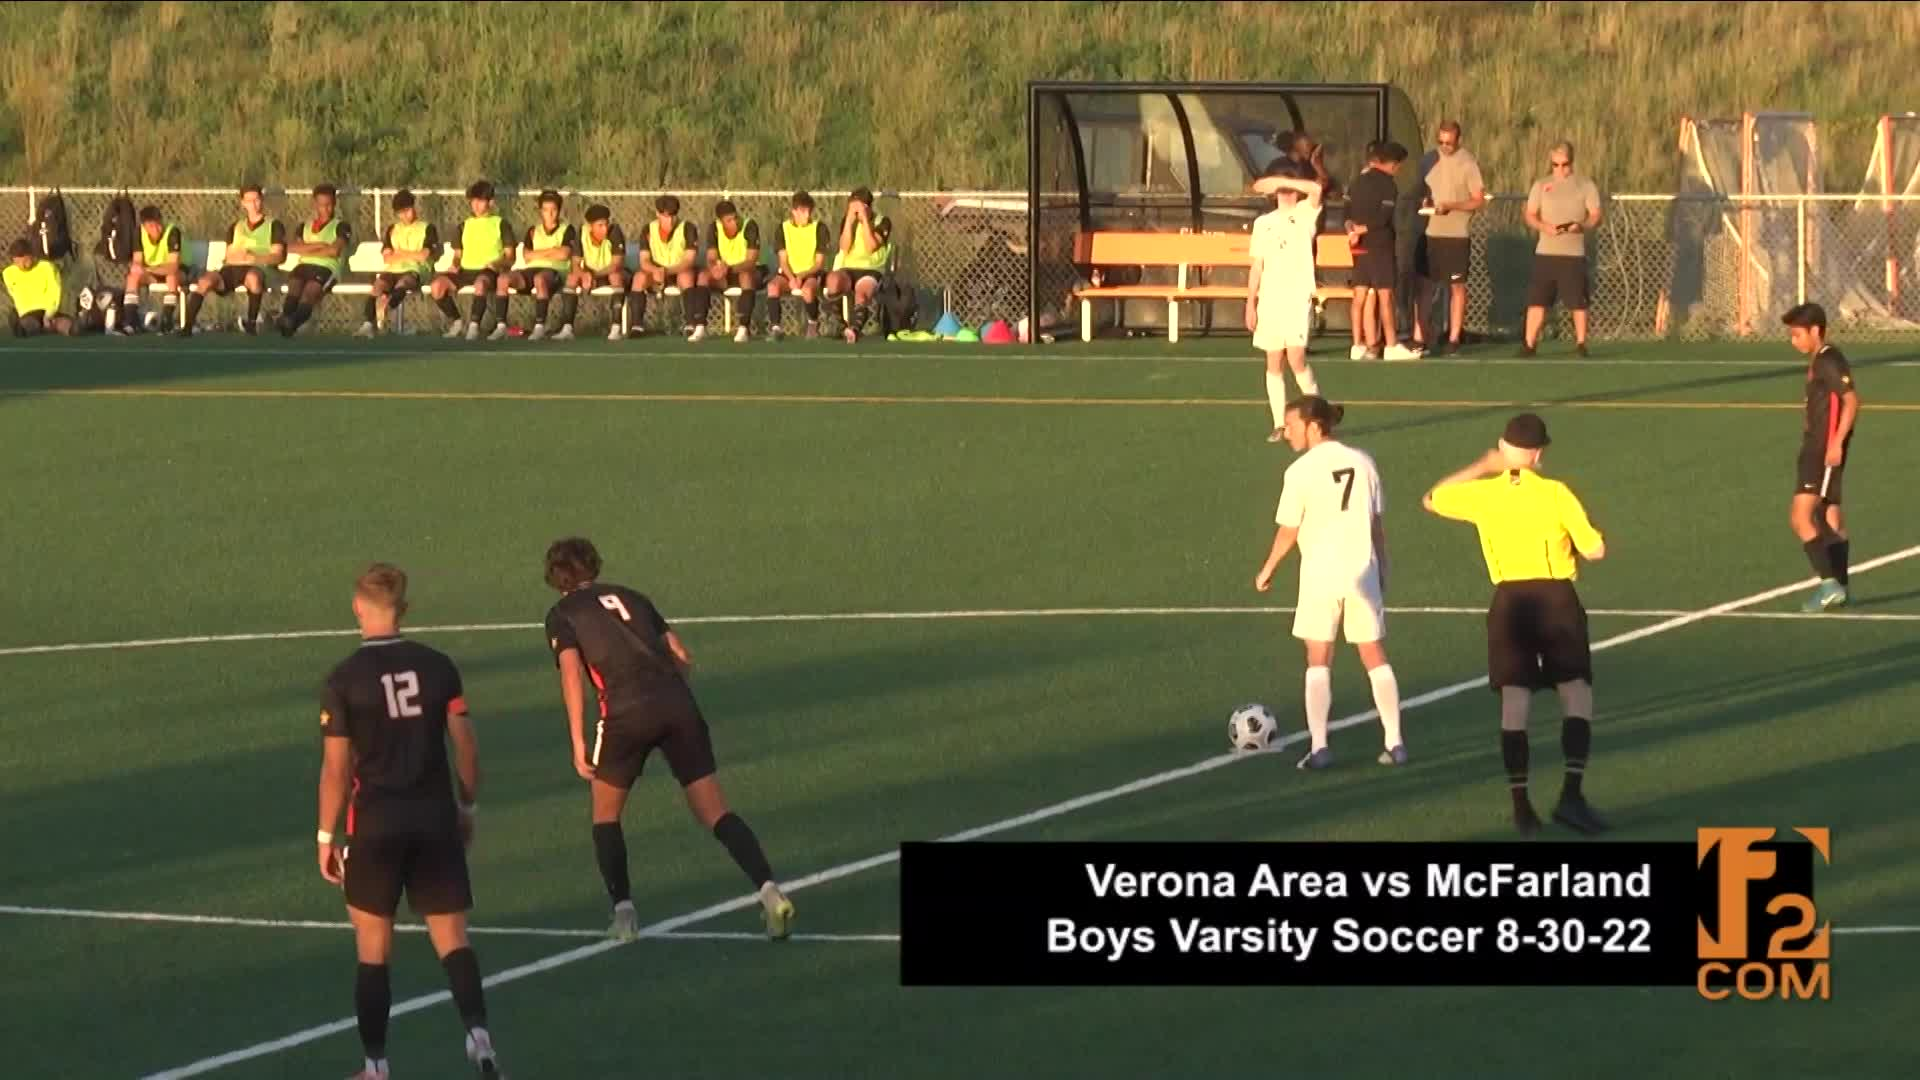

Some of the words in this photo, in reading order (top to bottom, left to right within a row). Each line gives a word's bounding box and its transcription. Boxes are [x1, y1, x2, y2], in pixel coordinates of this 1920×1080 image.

[1332, 467, 1355, 511] 7
[598, 593, 632, 621] 9
[380, 670, 423, 719] 12
